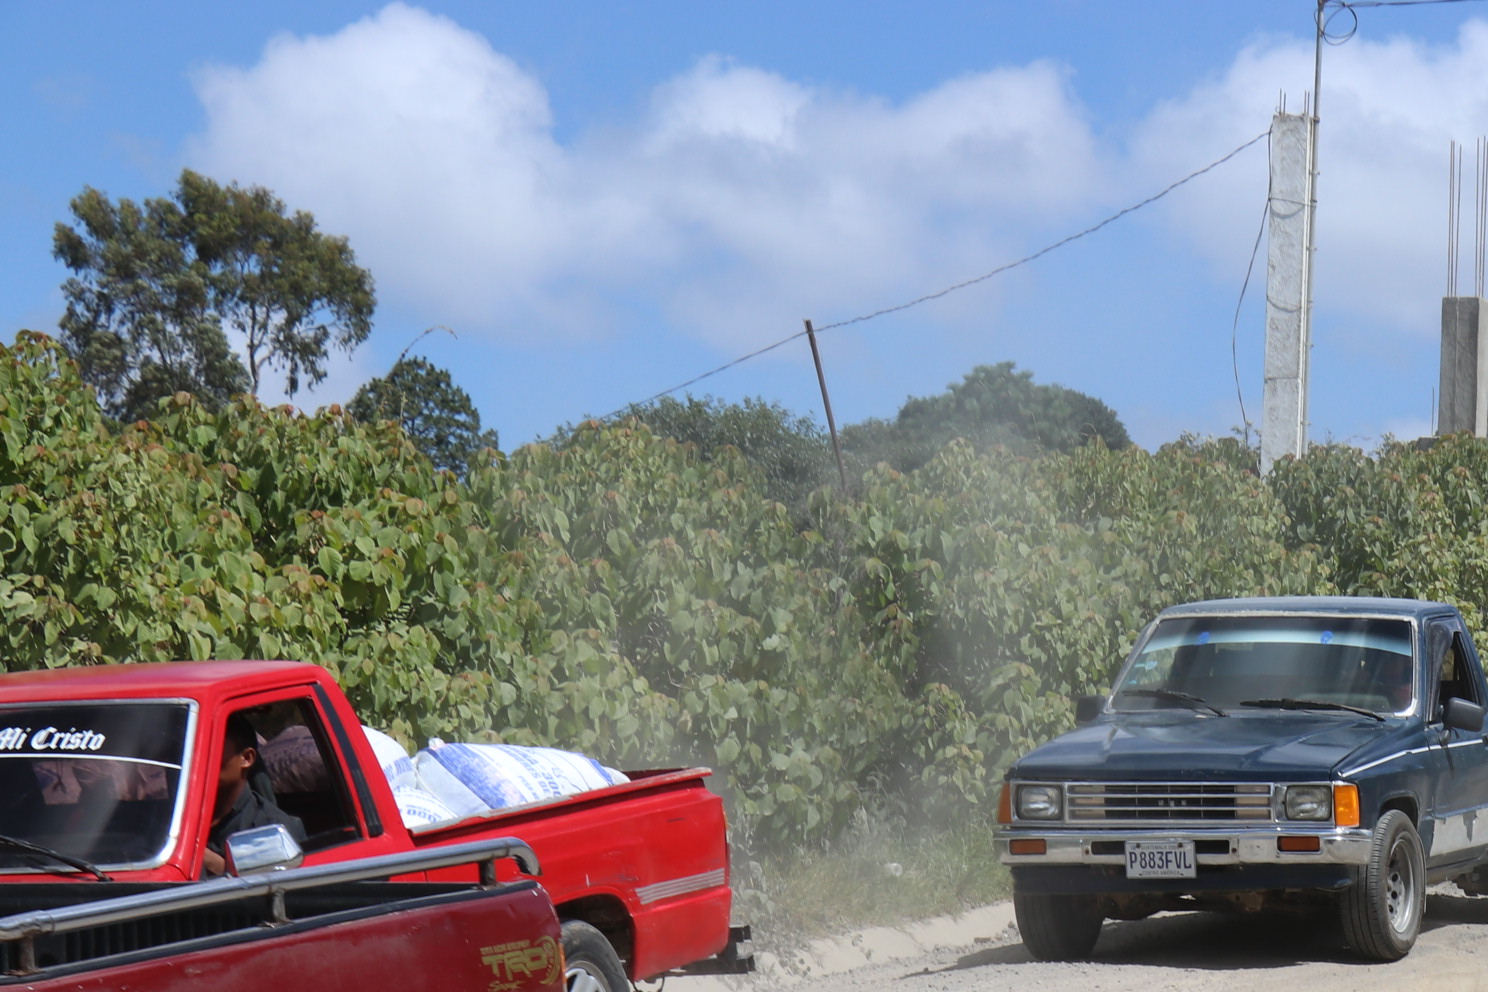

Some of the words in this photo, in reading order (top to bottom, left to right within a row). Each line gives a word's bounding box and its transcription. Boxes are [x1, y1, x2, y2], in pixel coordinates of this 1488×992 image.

[30, 727, 106, 751] Cristo
[1129, 851, 1192, 869] P883FVL
[482, 946, 548, 981] TRD
